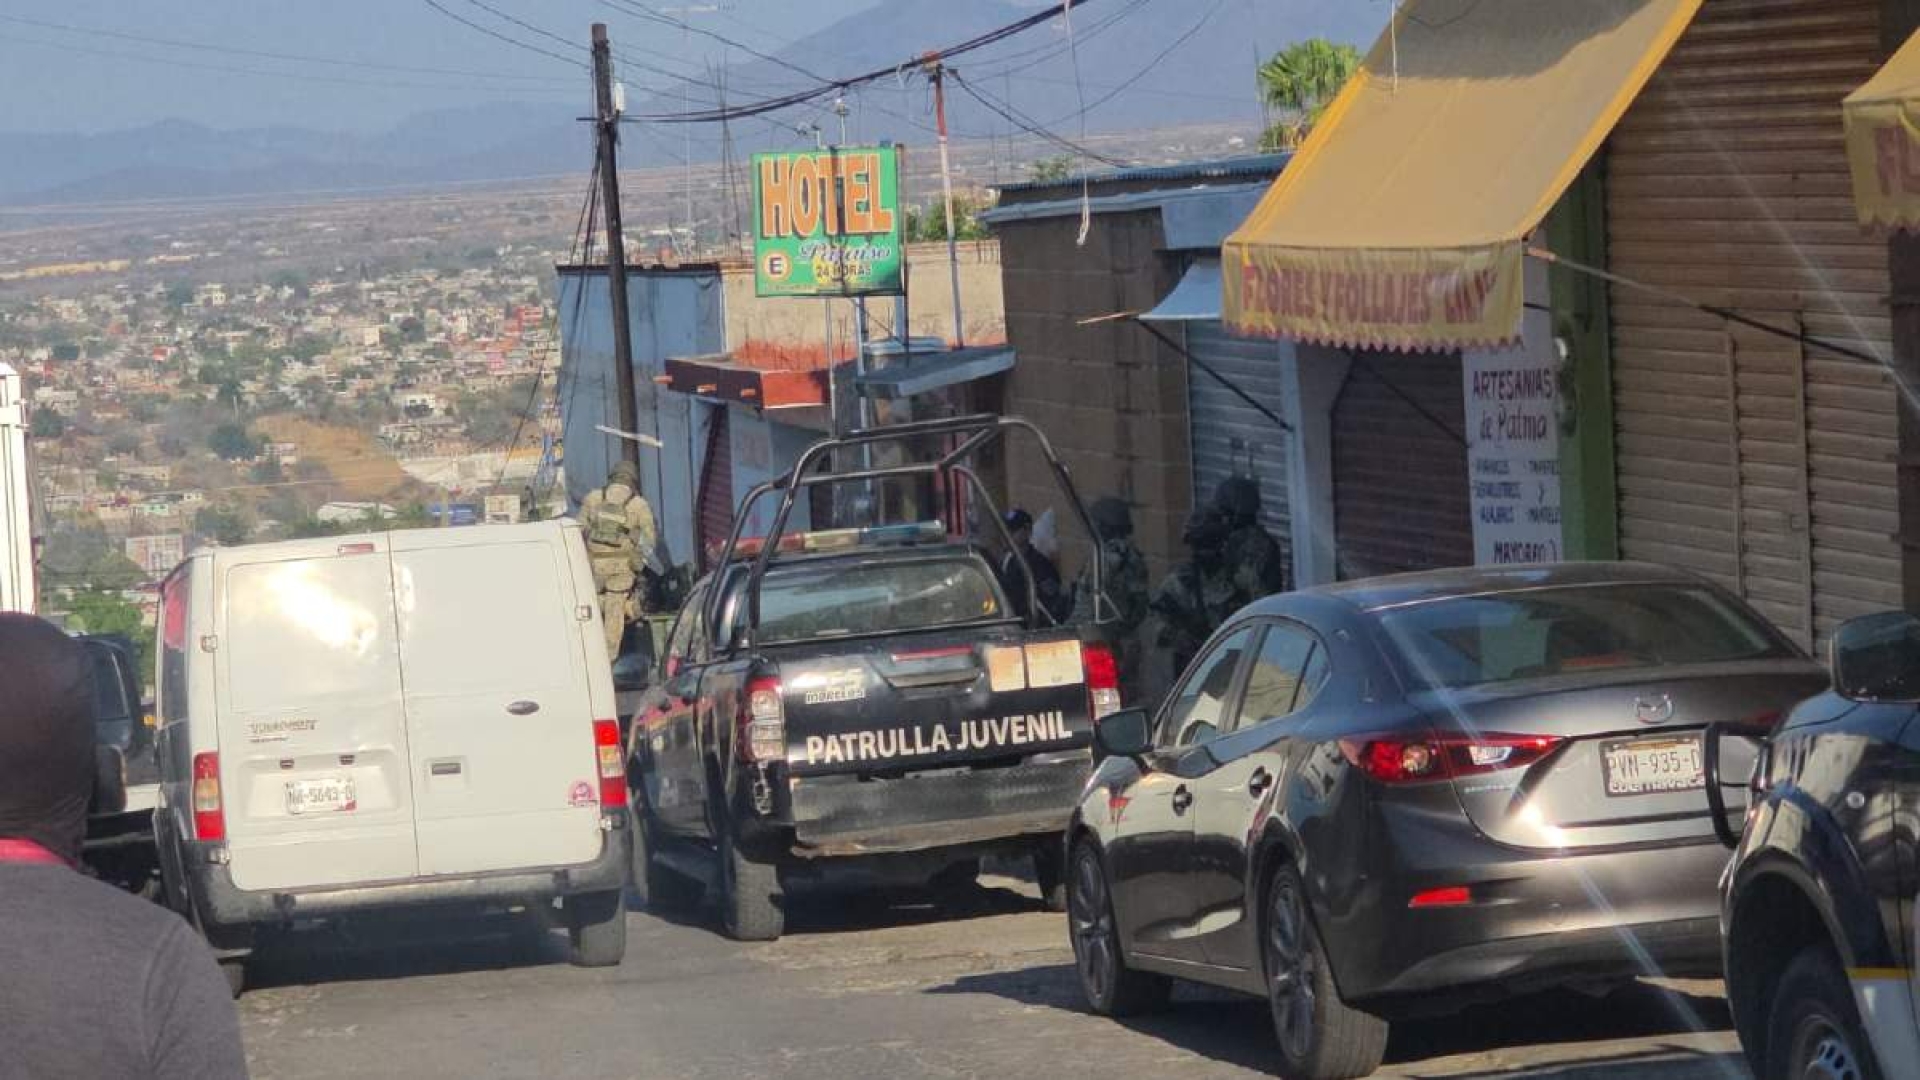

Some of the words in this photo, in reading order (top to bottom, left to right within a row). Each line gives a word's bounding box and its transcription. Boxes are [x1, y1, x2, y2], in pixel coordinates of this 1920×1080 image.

[760, 153, 894, 239] HOTEL
[769, 256, 782, 275] E
[1335, 270, 1430, 324] FOLLAJES
[1473, 367, 1553, 400] ARTESANIAS
[1497, 402, 1549, 443] Palma
[805, 723, 951, 764] PATRULLA
[955, 710, 1074, 751] JUVENIL
